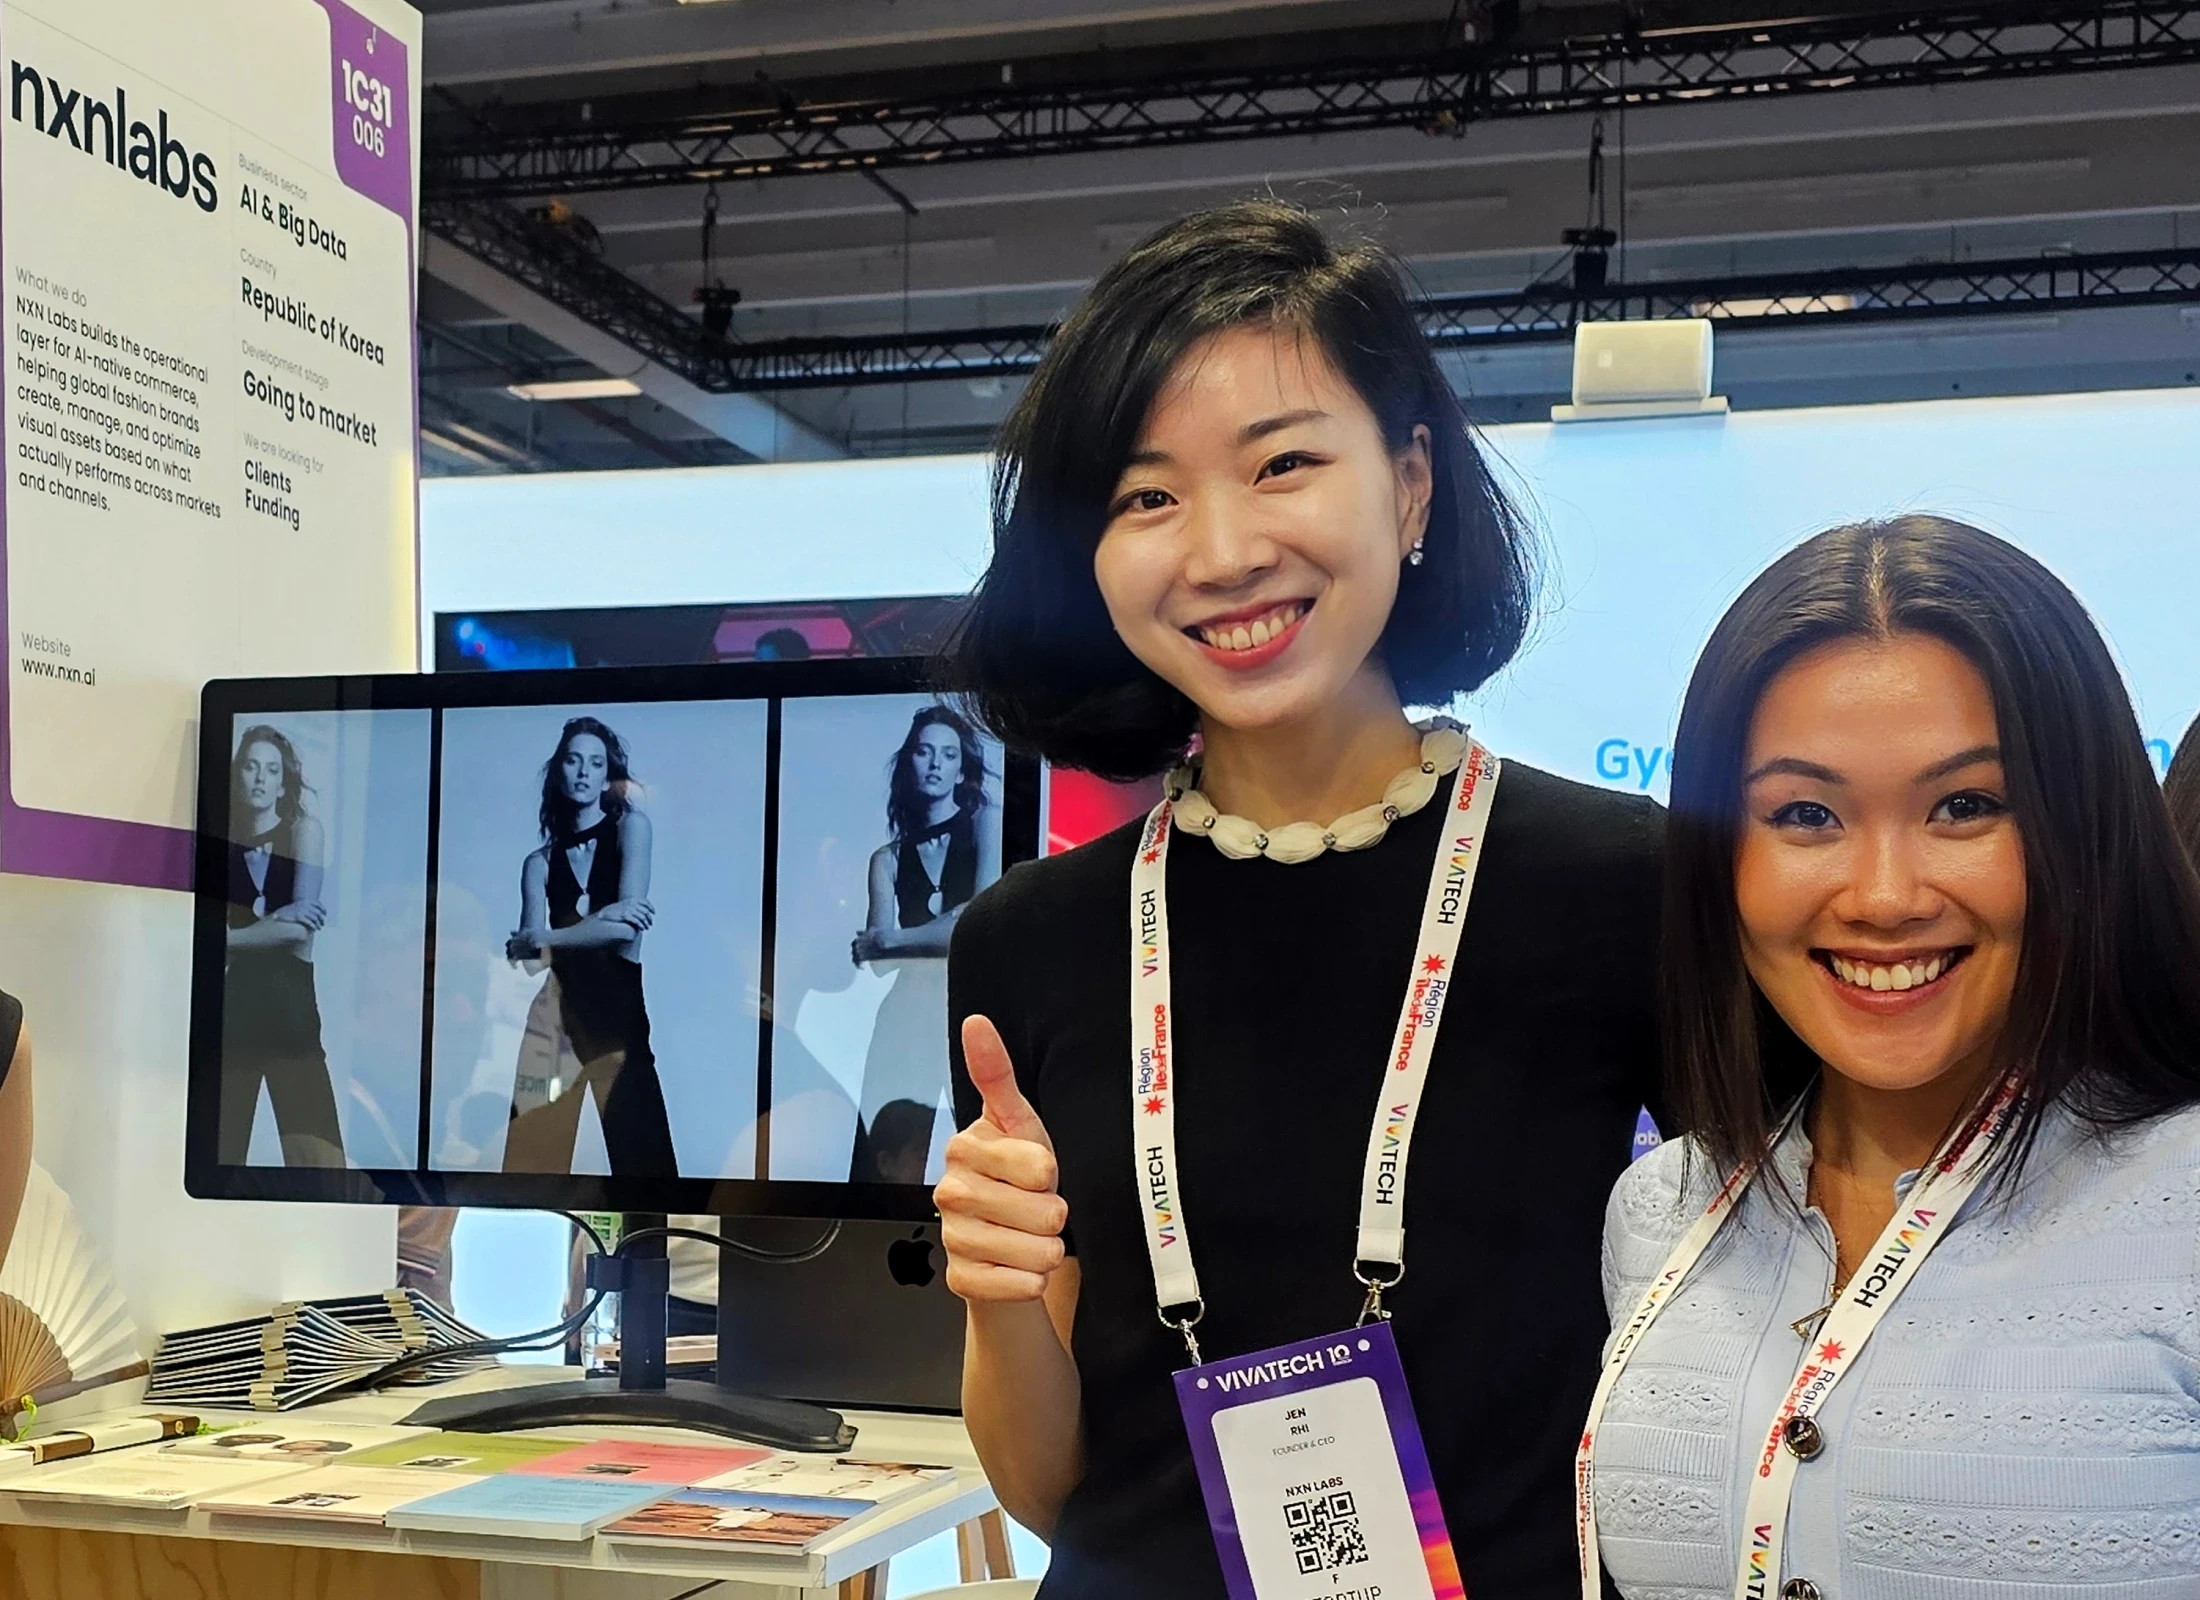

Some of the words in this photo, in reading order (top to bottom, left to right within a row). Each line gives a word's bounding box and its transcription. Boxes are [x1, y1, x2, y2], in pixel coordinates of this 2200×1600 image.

[341, 58, 392, 129] 1C31
[11, 59, 218, 213] nxnlabs
[352, 114, 385, 158] 006
[238, 153, 279, 187] Business
[280, 178, 308, 202] sector
[240, 183, 257, 215] AI
[261, 195, 274, 225] &
[278, 202, 304, 247] Big
[308, 218, 347, 262] Data
[15, 265, 49, 295] What
[51, 282, 69, 301] we
[71, 288, 88, 308] do
[240, 248, 277, 281] Country
[16, 295, 44, 321] NXN
[47, 307, 77, 334] Labs
[80, 318, 118, 348] builds
[121, 335, 141, 357] the
[143, 348, 209, 384] operational
[241, 276, 316, 334] Republic
[320, 316, 336, 344] of
[339, 322, 385, 367] Korea
[16, 323, 51, 353] layer
[53, 336, 71, 358] for
[74, 346, 132, 381] AI-native
[134, 368, 200, 409] commerce,
[241, 339, 302, 378] Development
[304, 368, 330, 391] stage
[17, 352, 67, 391] helping
[70, 373, 110, 401] global
[112, 384, 157, 418] fashion
[159, 403, 200, 433] brands
[243, 369, 295, 422] Going
[299, 391, 316, 421] to
[319, 403, 377, 447] market
[17, 384, 64, 415] create,
[67, 400, 124, 435] manage,
[126, 418, 149, 441] and
[152, 429, 201, 459] optimize
[18, 411, 57, 439] visual
[60, 426, 102, 453] assets
[105, 438, 142, 466] based
[145, 454, 161, 472] on
[162, 458, 192, 483] what
[243, 432, 259, 450] We
[261, 441, 277, 456] are
[278, 443, 311, 473] looking
[312, 457, 325, 475] for
[244, 459, 292, 494] Clients
[18, 442, 72, 476] actually
[75, 459, 132, 490] performs
[134, 478, 173, 504] across
[175, 491, 222, 518] markets
[19, 470, 46, 493] and
[48, 478, 111, 512] channels.
[245, 487, 300, 531] Funding
[21, 632, 71, 657] Website
[21, 658, 96, 687] www.nxn.ai
[1437, 837, 1474, 924] VIVATECH
[1141, 889, 1159, 978] VIVATECH
[1422, 979, 1447, 1028] Région
[1138, 1047, 1154, 1095] Région
[1376, 1104, 1409, 1205] VIVATECH
[1142, 1146, 1177, 1249] VIVATECH
[1853, 1208, 1937, 1308] VIVATECH
[1612, 1268, 1680, 1364] VIVATECH
[1215, 1351, 1325, 1392] VIVATECH
[1326, 1344, 1352, 1366] 10
[1284, 1407, 1306, 1420] JEN
[1796, 1369, 1836, 1419] Régio
[1272, 1441, 1309, 1456] FOUNDER
[1317, 1435, 1335, 1446] CEO
[1290, 1423, 1310, 1435] RHI
[1285, 1483, 1312, 1497] NXN
[1313, 1476, 1343, 1491] LABS
[1332, 1573, 1340, 1584] F
[1746, 1524, 1772, 1600] VIVAT
